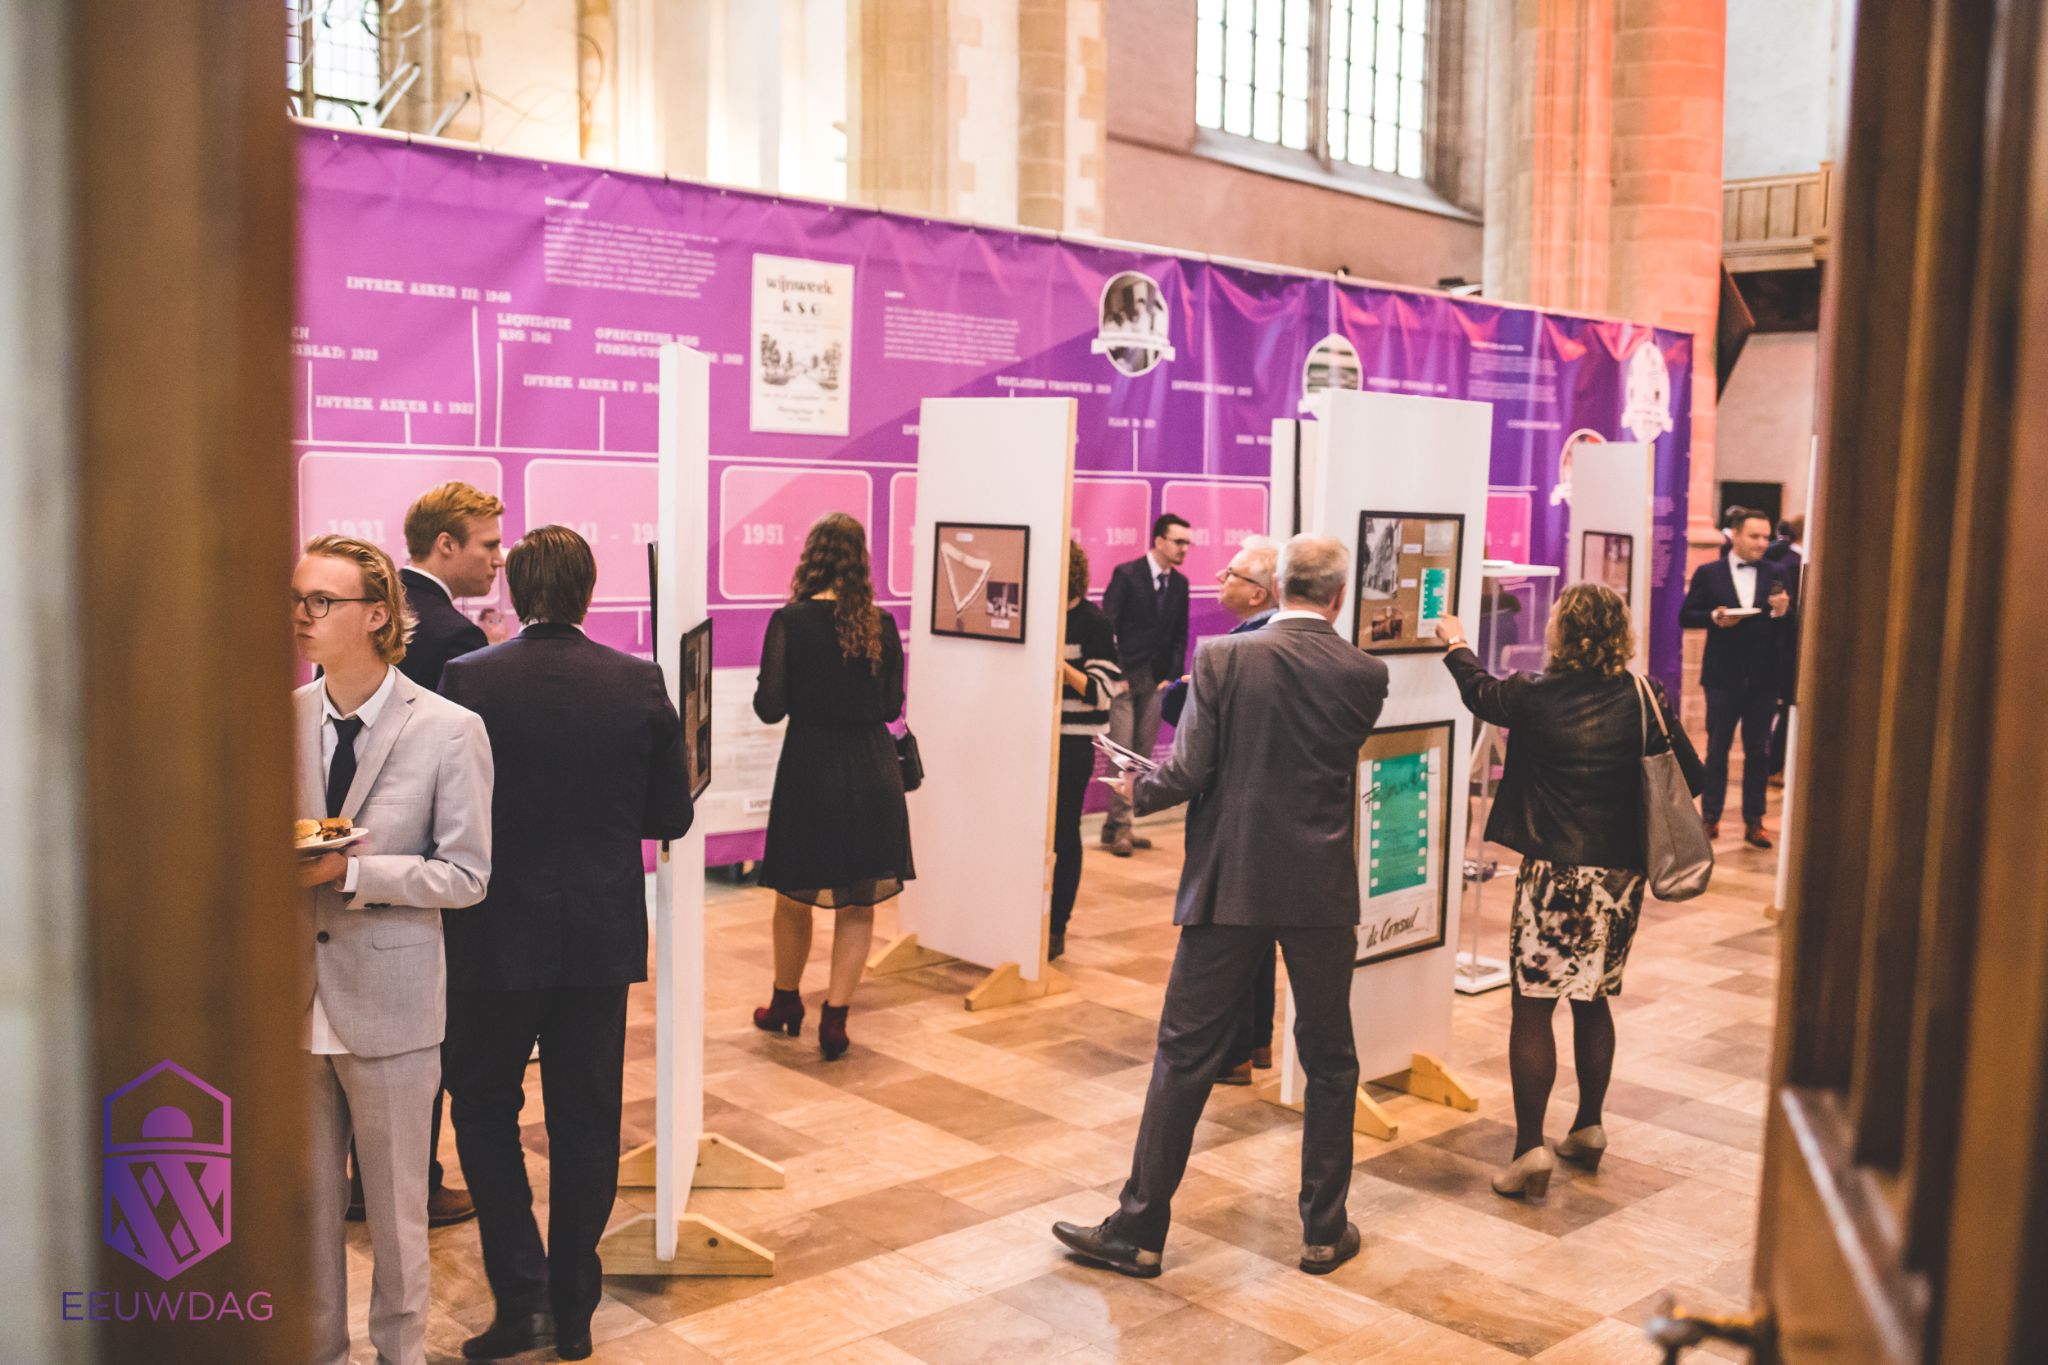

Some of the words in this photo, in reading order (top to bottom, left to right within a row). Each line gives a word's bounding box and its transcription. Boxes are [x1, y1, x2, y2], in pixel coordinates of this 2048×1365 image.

[346, 276, 404, 293] INTREK
[315, 394, 374, 411] INTREK
[742, 523, 785, 546] 1951
